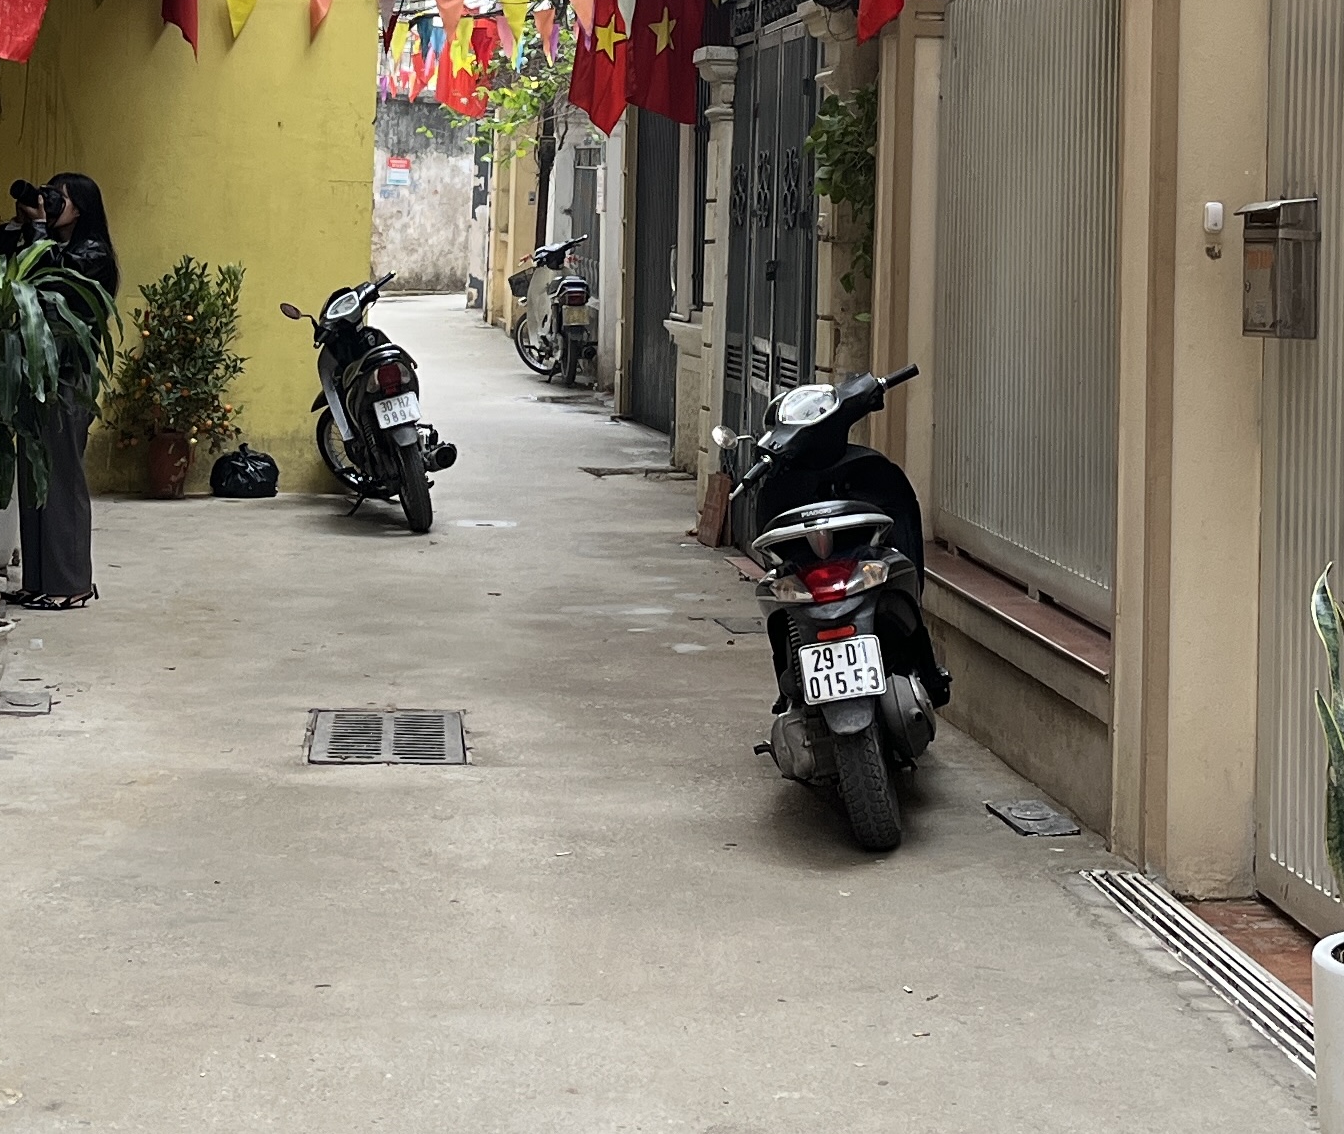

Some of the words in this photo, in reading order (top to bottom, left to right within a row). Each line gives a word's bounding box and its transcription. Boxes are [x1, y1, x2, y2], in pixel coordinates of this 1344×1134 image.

[379, 396, 412, 413] 30-H2
[810, 641, 869, 673] 29-D1
[809, 666, 881, 700] 015.53
